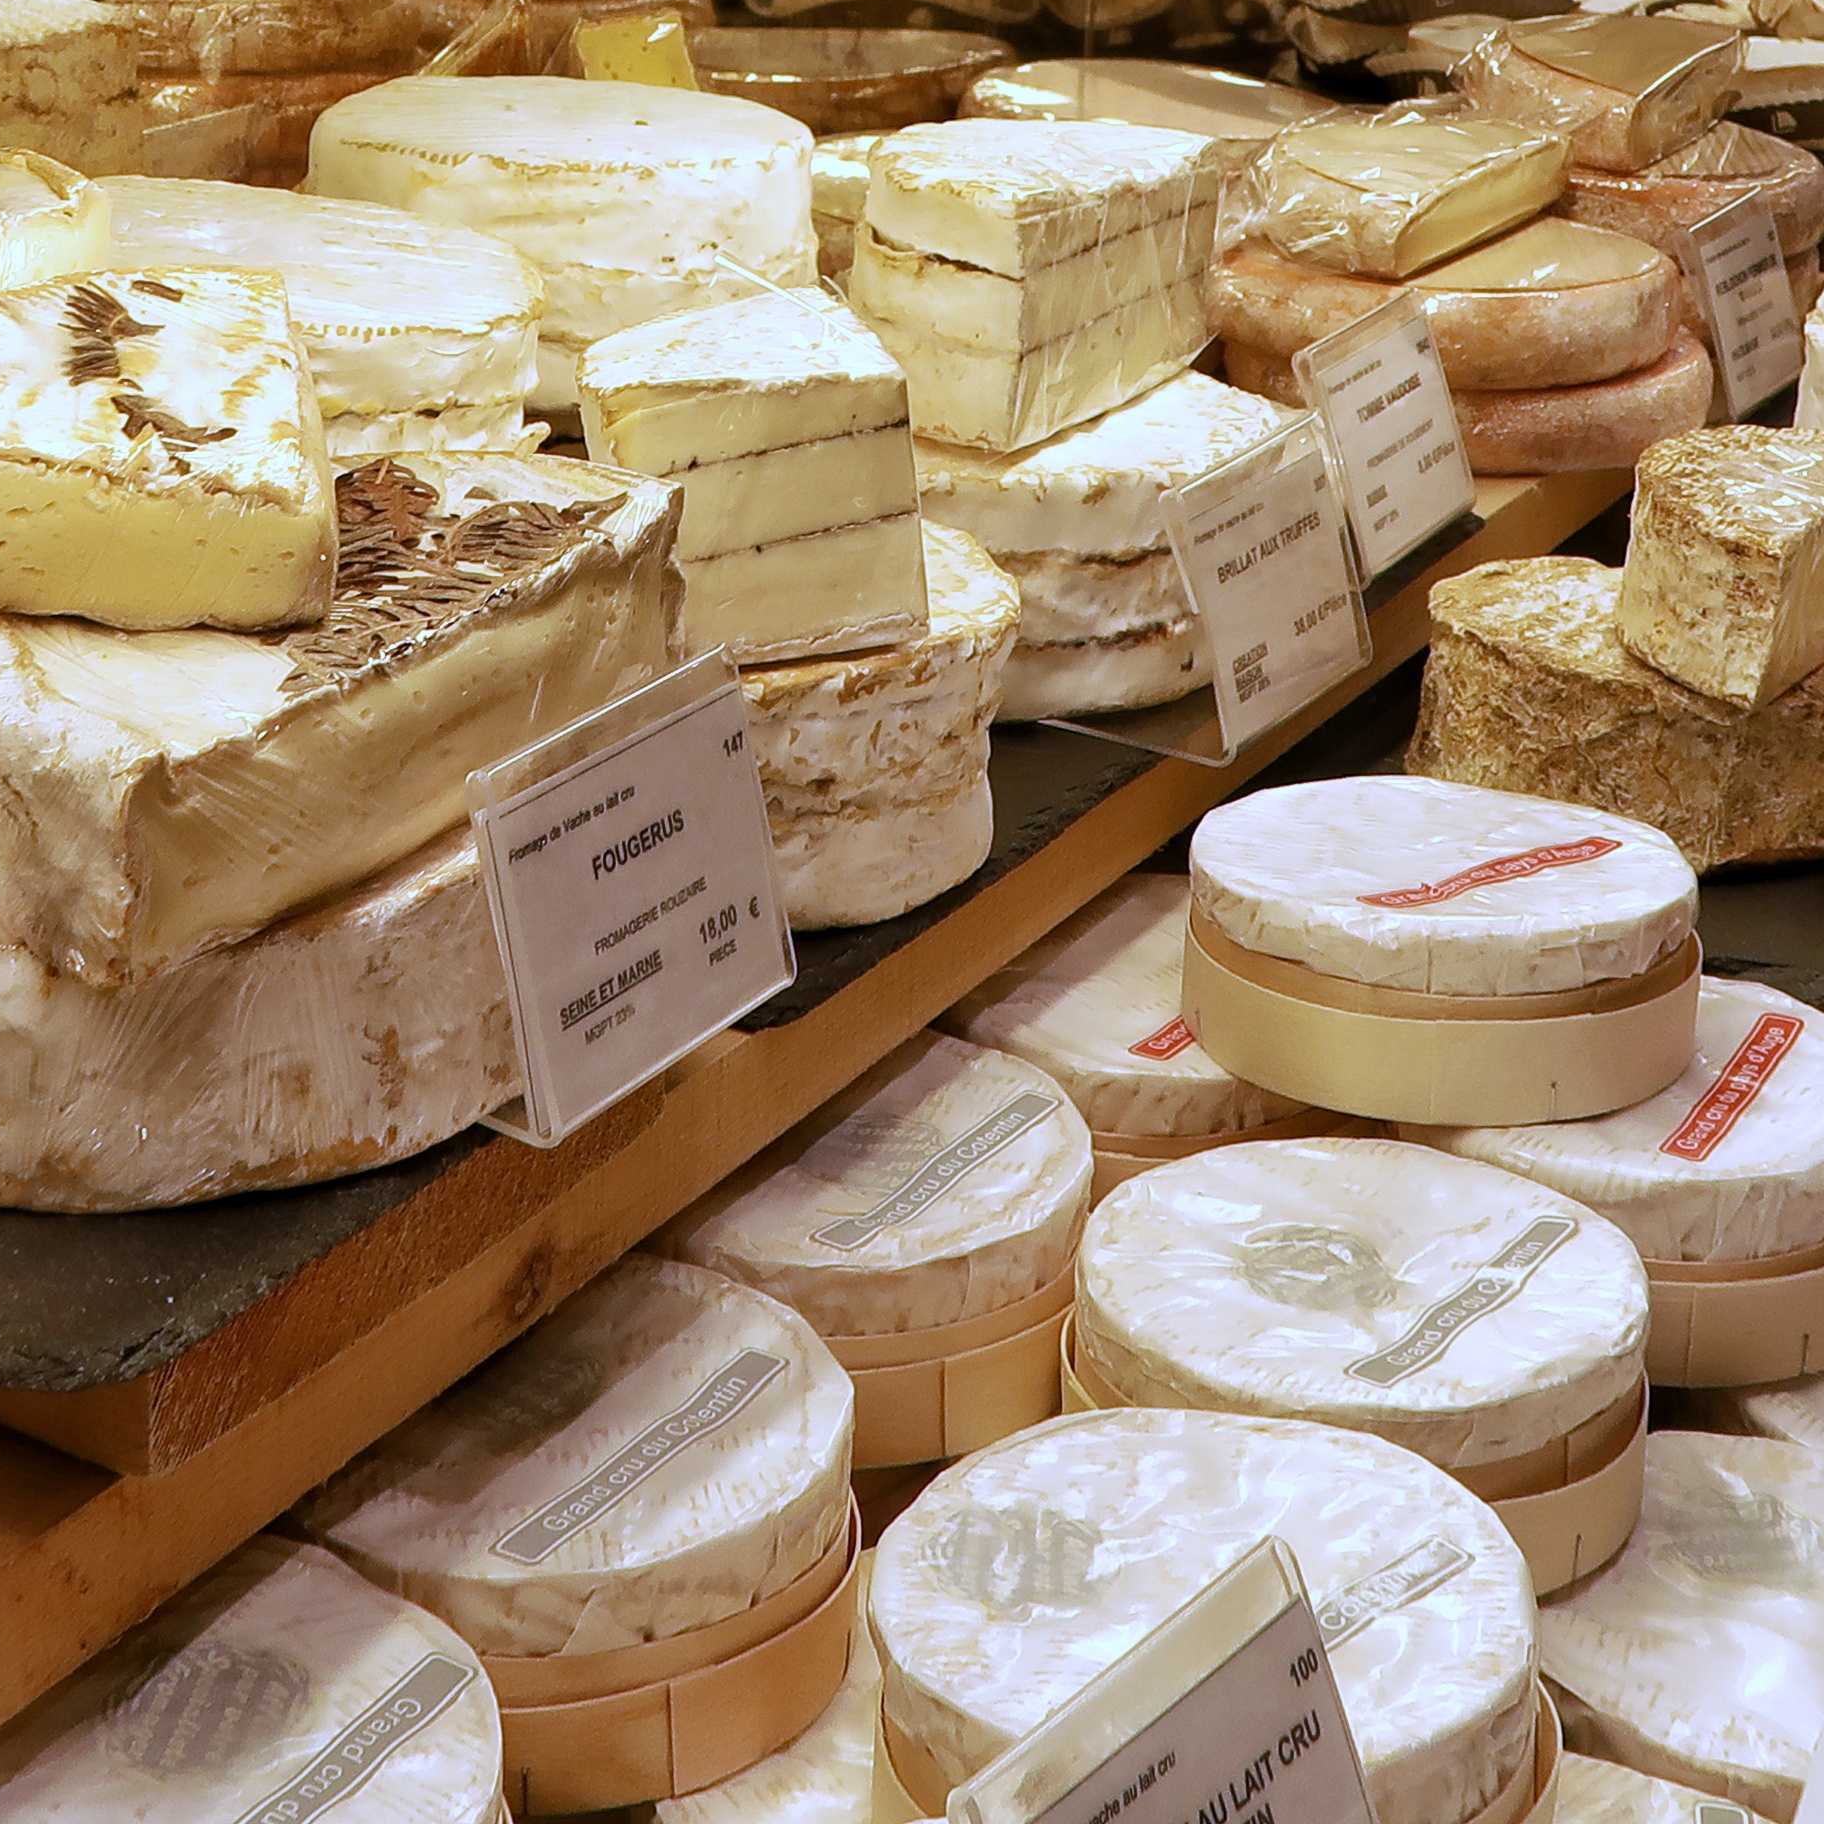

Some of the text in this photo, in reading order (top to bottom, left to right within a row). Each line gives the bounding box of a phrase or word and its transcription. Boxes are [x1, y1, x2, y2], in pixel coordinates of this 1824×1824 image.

[1217, 511, 1321, 584] BRILLAT AUX TRUFFES
[722, 730, 744, 758] 147
[509, 834, 549, 866] Fromage
[549, 824, 562, 844] de
[593, 800, 605, 817] au
[606, 790, 619, 813] lait
[620, 784, 635, 806] cru
[591, 808, 685, 880] FOUGERUS
[594, 907, 659, 956] FROMAGERIE
[698, 895, 761, 946] 18,00 €
[708, 939, 737, 967] PIECE
[559, 948, 663, 1031] SEINE ET MARNE
[584, 1017, 615, 1045] MGPT
[1676, 1120, 1715, 1150] Grand
[1746, 1026, 1786, 1064] d'Auge
[910, 1113, 1027, 1202] cru du Cotentin
[1386, 1294, 1487, 1366] Grand cru du
[542, 1375, 749, 1532] Grand cru du Cotentin
[1290, 1648, 1319, 1688] 100
[258, 1697, 422, 1824] Grand cru du
[1123, 1785, 1138, 1808] au
[1138, 1766, 1157, 1794] lait
[1157, 1750, 1176, 1778] cru
[1198, 1709, 1321, 1824] AU LAIT CRU
